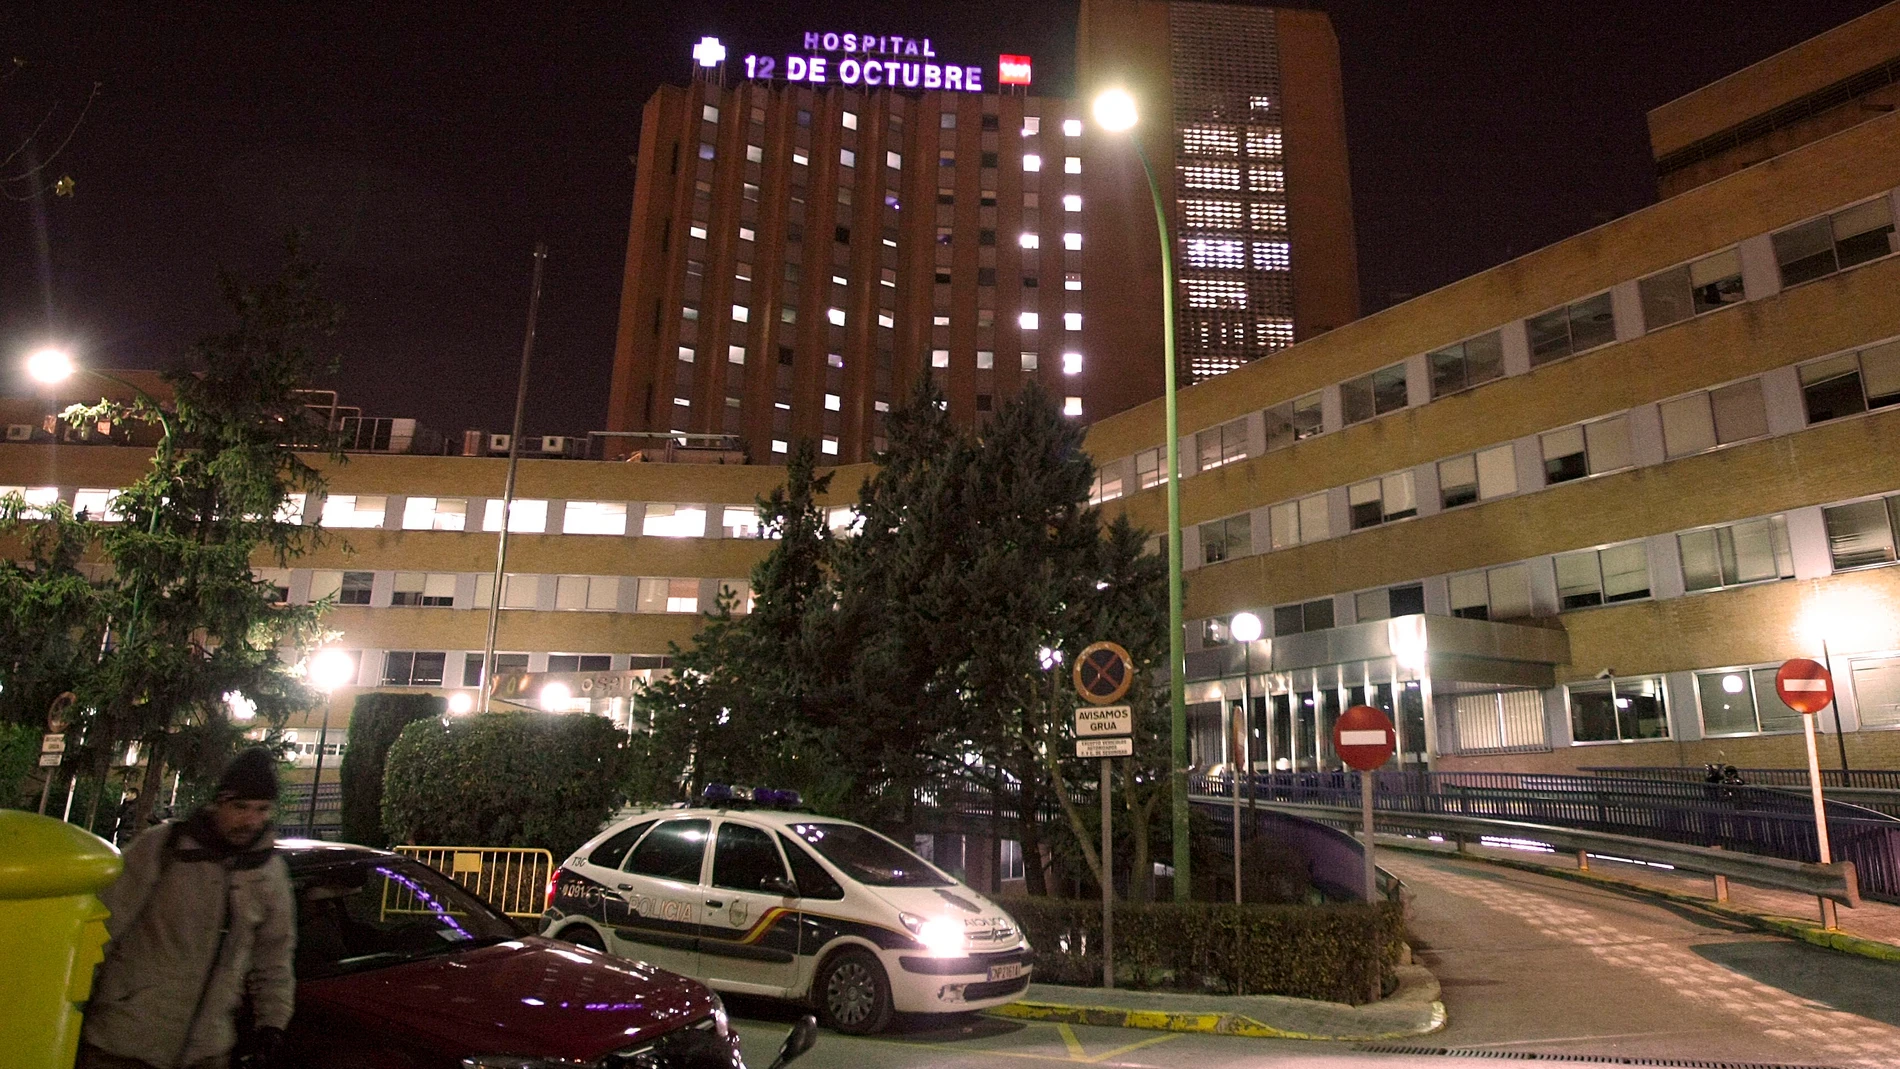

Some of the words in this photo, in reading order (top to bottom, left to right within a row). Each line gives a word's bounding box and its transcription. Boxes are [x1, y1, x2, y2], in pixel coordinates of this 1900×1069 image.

[804, 31, 935, 57] HOSPITAL
[745, 54, 776, 79] 12
[787, 56, 827, 83] DE
[838, 59, 982, 91] OCTUBRE
[1079, 709, 1128, 720] AVISAMOS
[1090, 721, 1117, 731] GRUA
[628, 895, 693, 921] POLICIA
